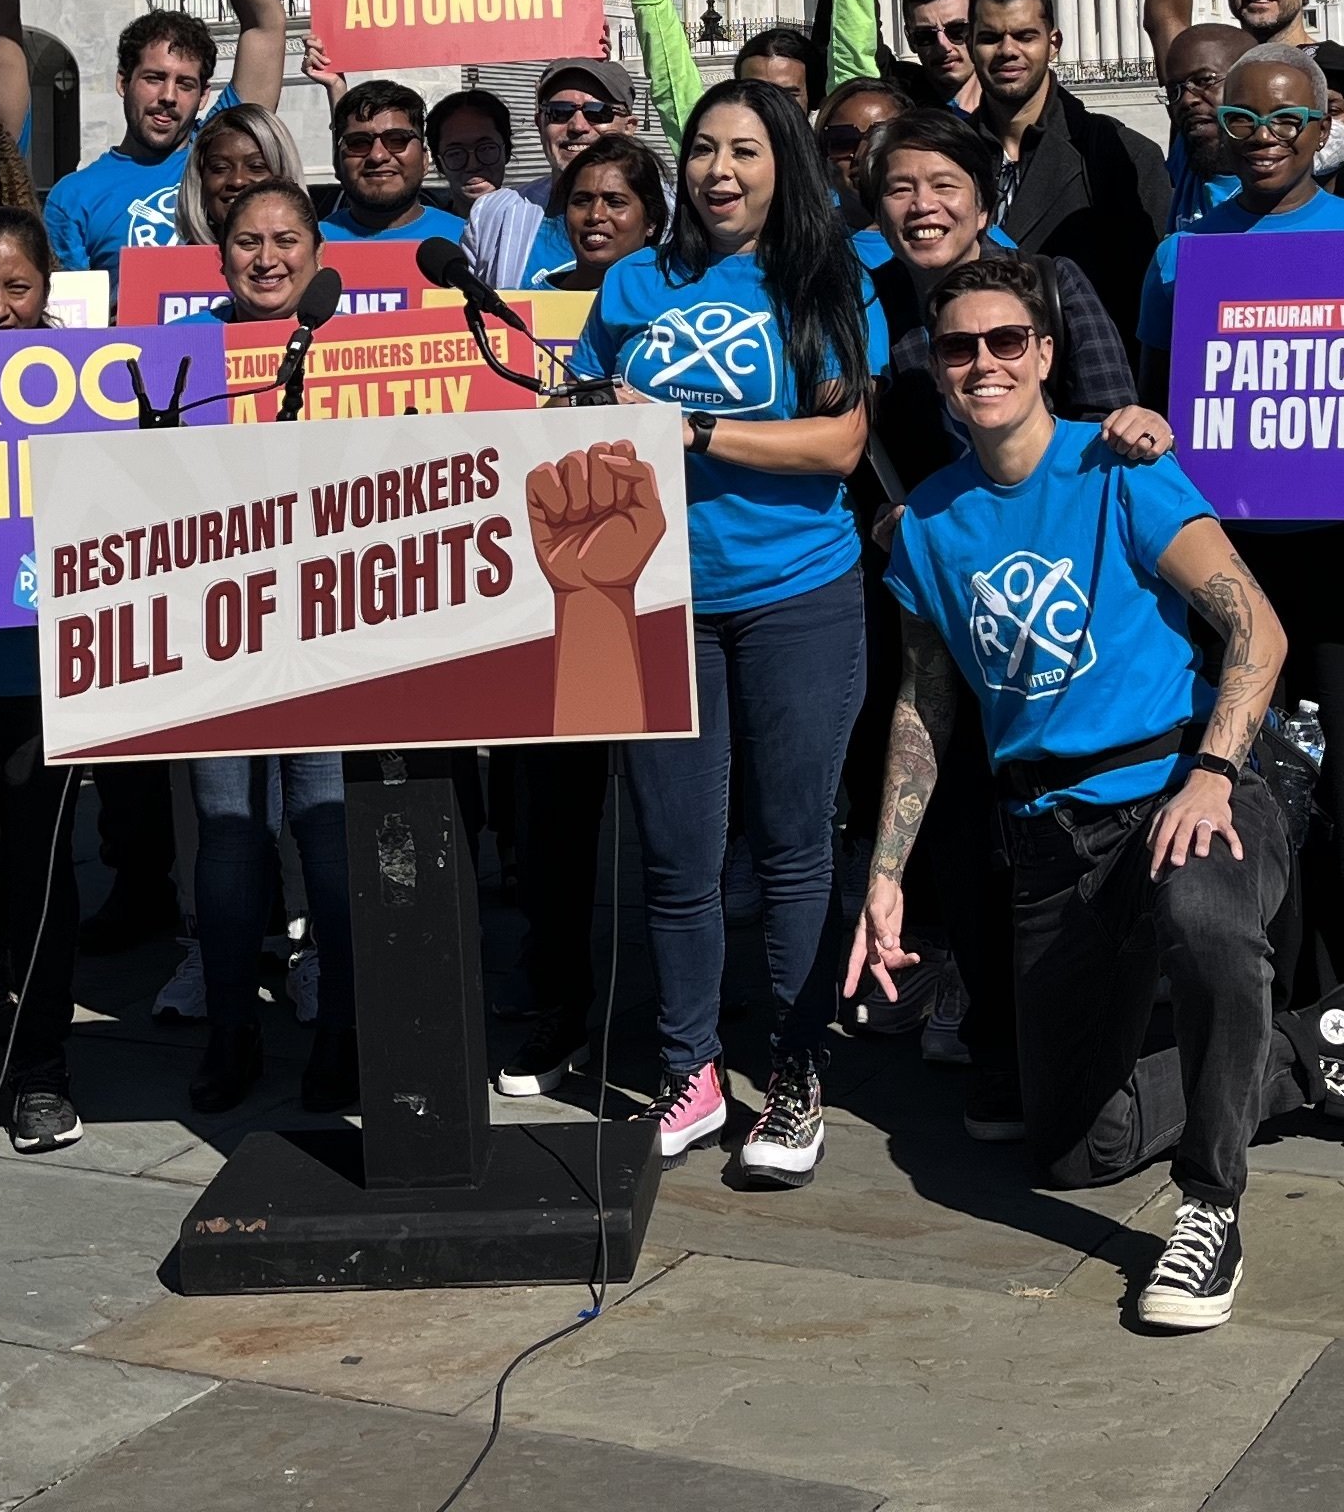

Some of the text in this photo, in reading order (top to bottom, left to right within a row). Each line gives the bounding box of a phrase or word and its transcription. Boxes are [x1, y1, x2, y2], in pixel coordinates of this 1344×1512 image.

[1222, 303, 1335, 330] RESTAURANT
[322, 341, 414, 373] WORKERS
[420, 335, 502, 365] DESERE
[232, 394, 258, 425] A
[669, 385, 725, 406] UNITED
[1192, 397, 1235, 451] IN
[52, 445, 501, 598] RESTAURANT WORKERS
[54, 513, 514, 700] BILL OF RIGHTS
